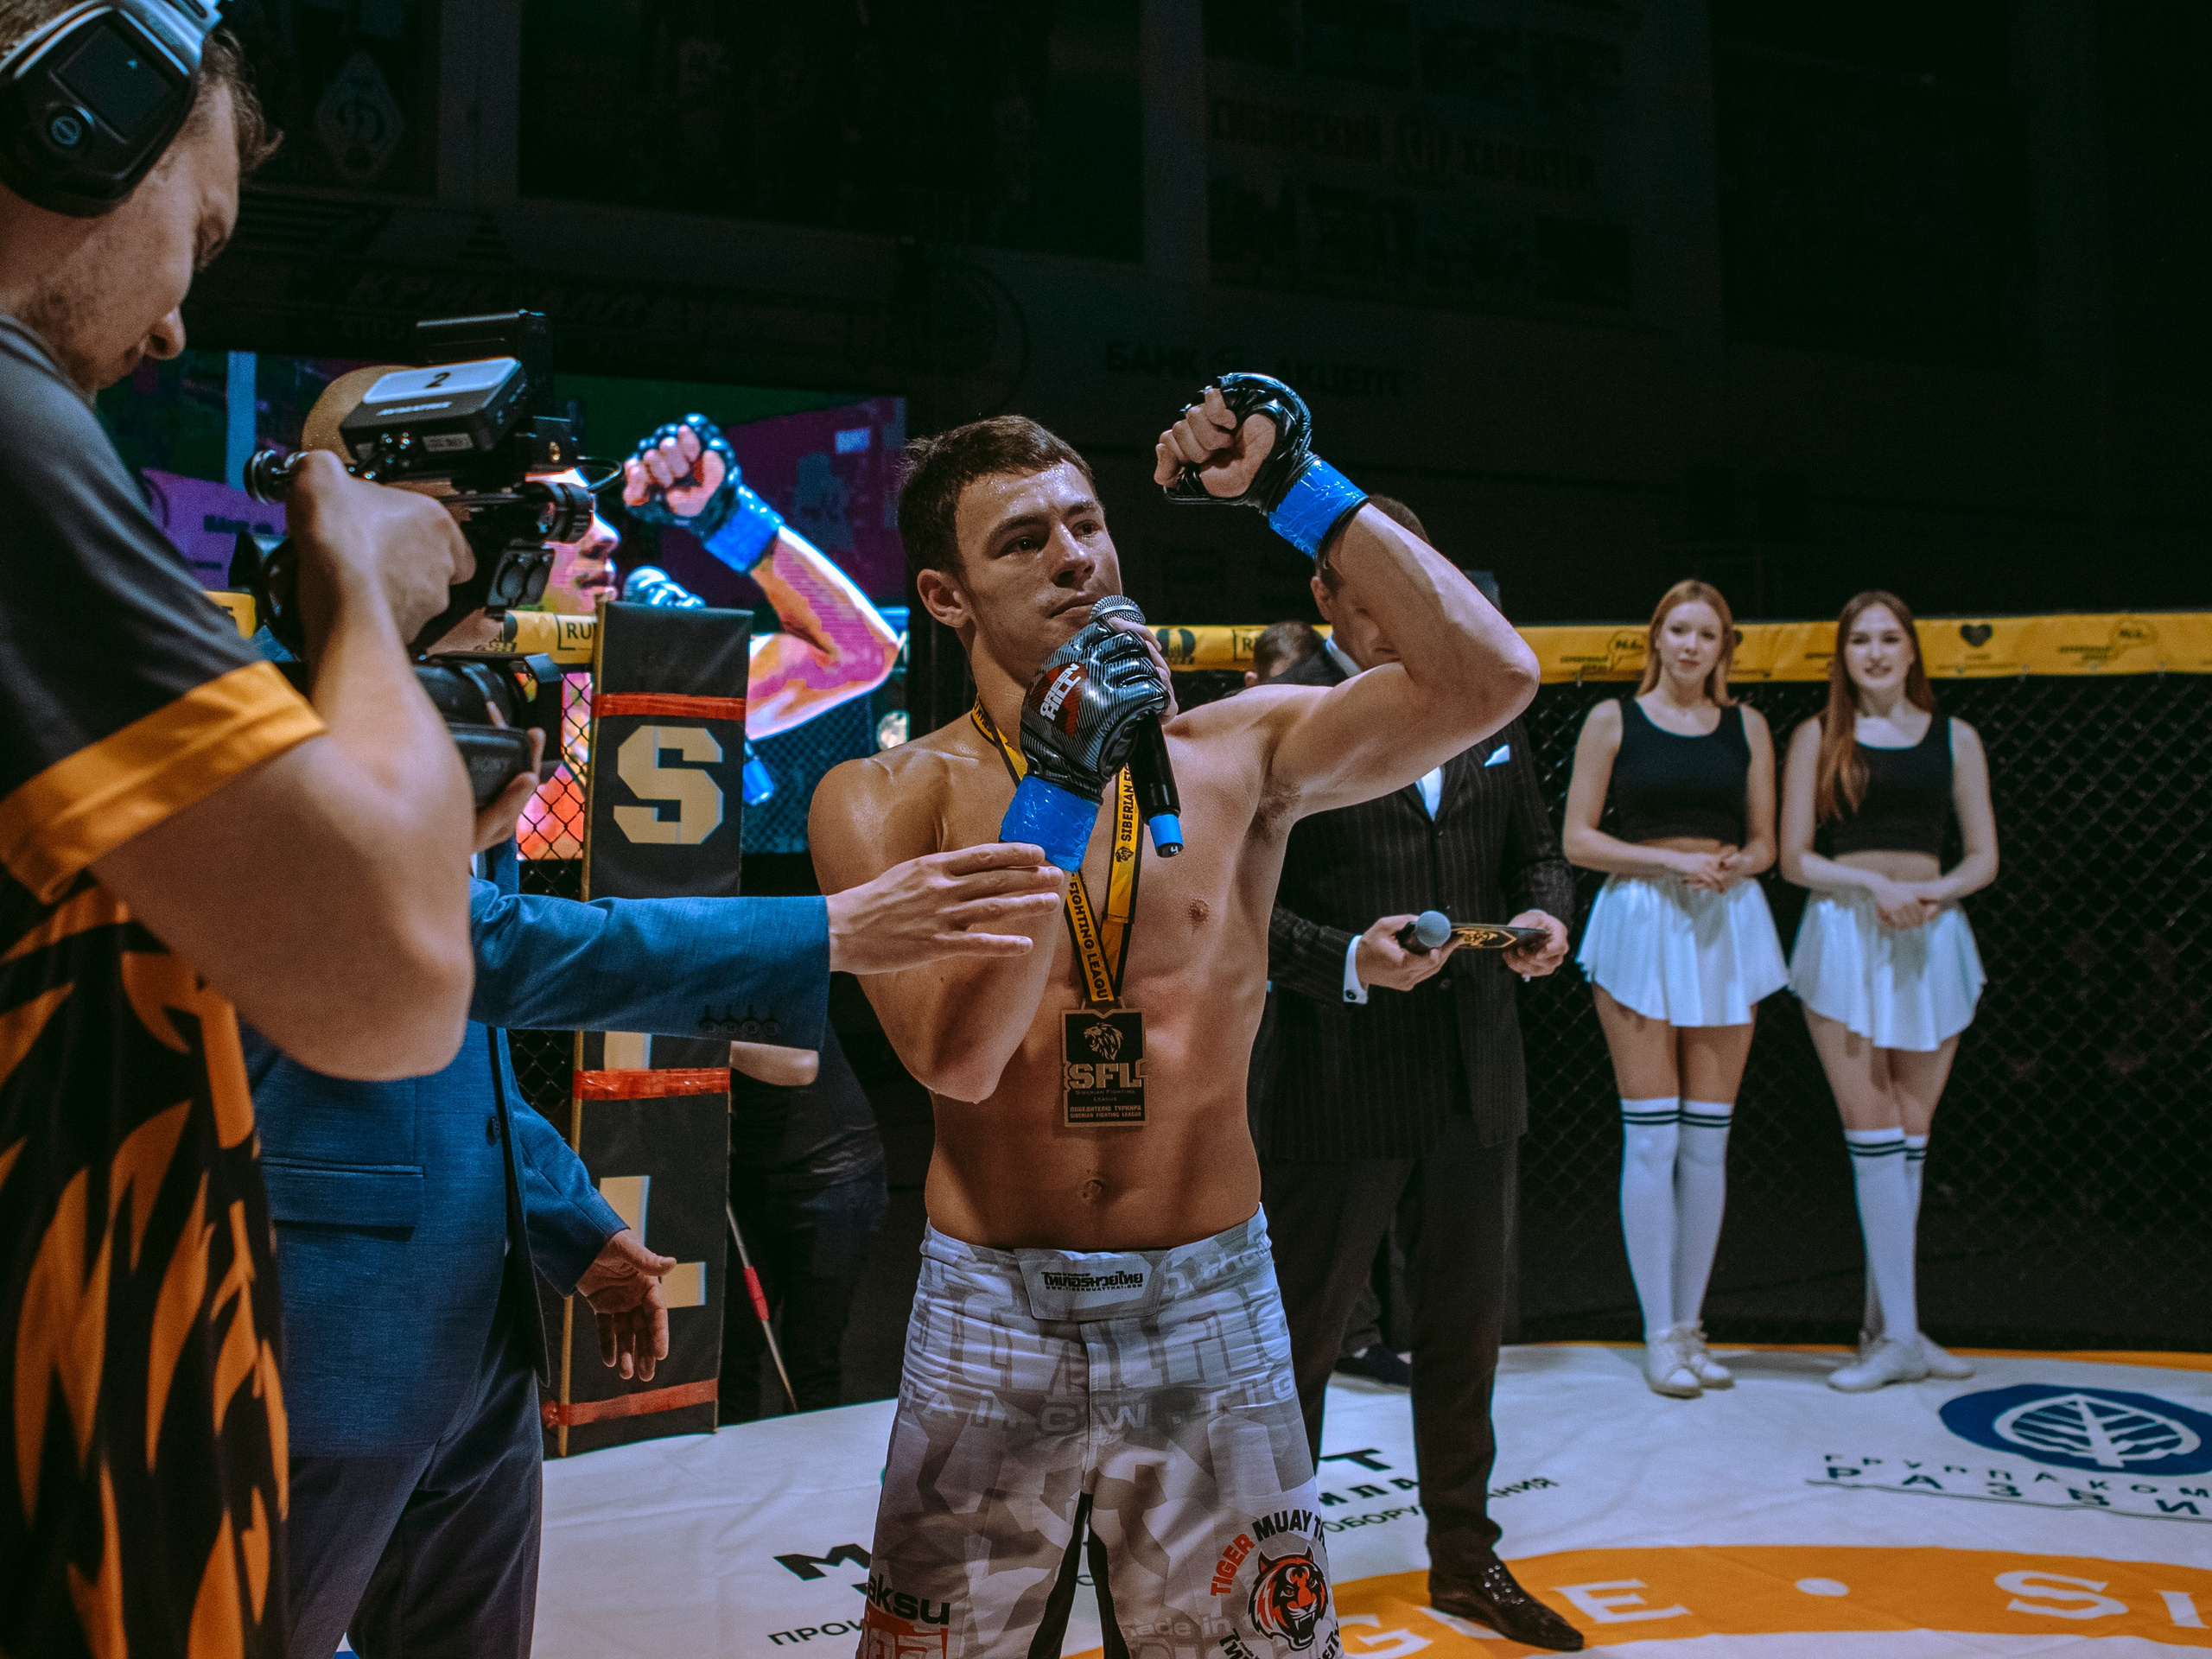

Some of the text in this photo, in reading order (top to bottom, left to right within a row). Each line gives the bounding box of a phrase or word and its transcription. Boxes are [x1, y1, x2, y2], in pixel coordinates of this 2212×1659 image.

[424, 372, 451, 389] 2
[1104, 339, 1200, 381] БАНК
[1040, 663, 1080, 716] GREEN
[1046, 676, 1082, 721] HILL
[1121, 785, 1134, 842] SIBERIAN
[1069, 881, 1109, 1001] FIGHTING LEAGU
[1069, 1062, 1142, 1089] SFL
[1211, 1533, 1255, 1597] TIGER
[1251, 1509, 1313, 1542] MUAY
